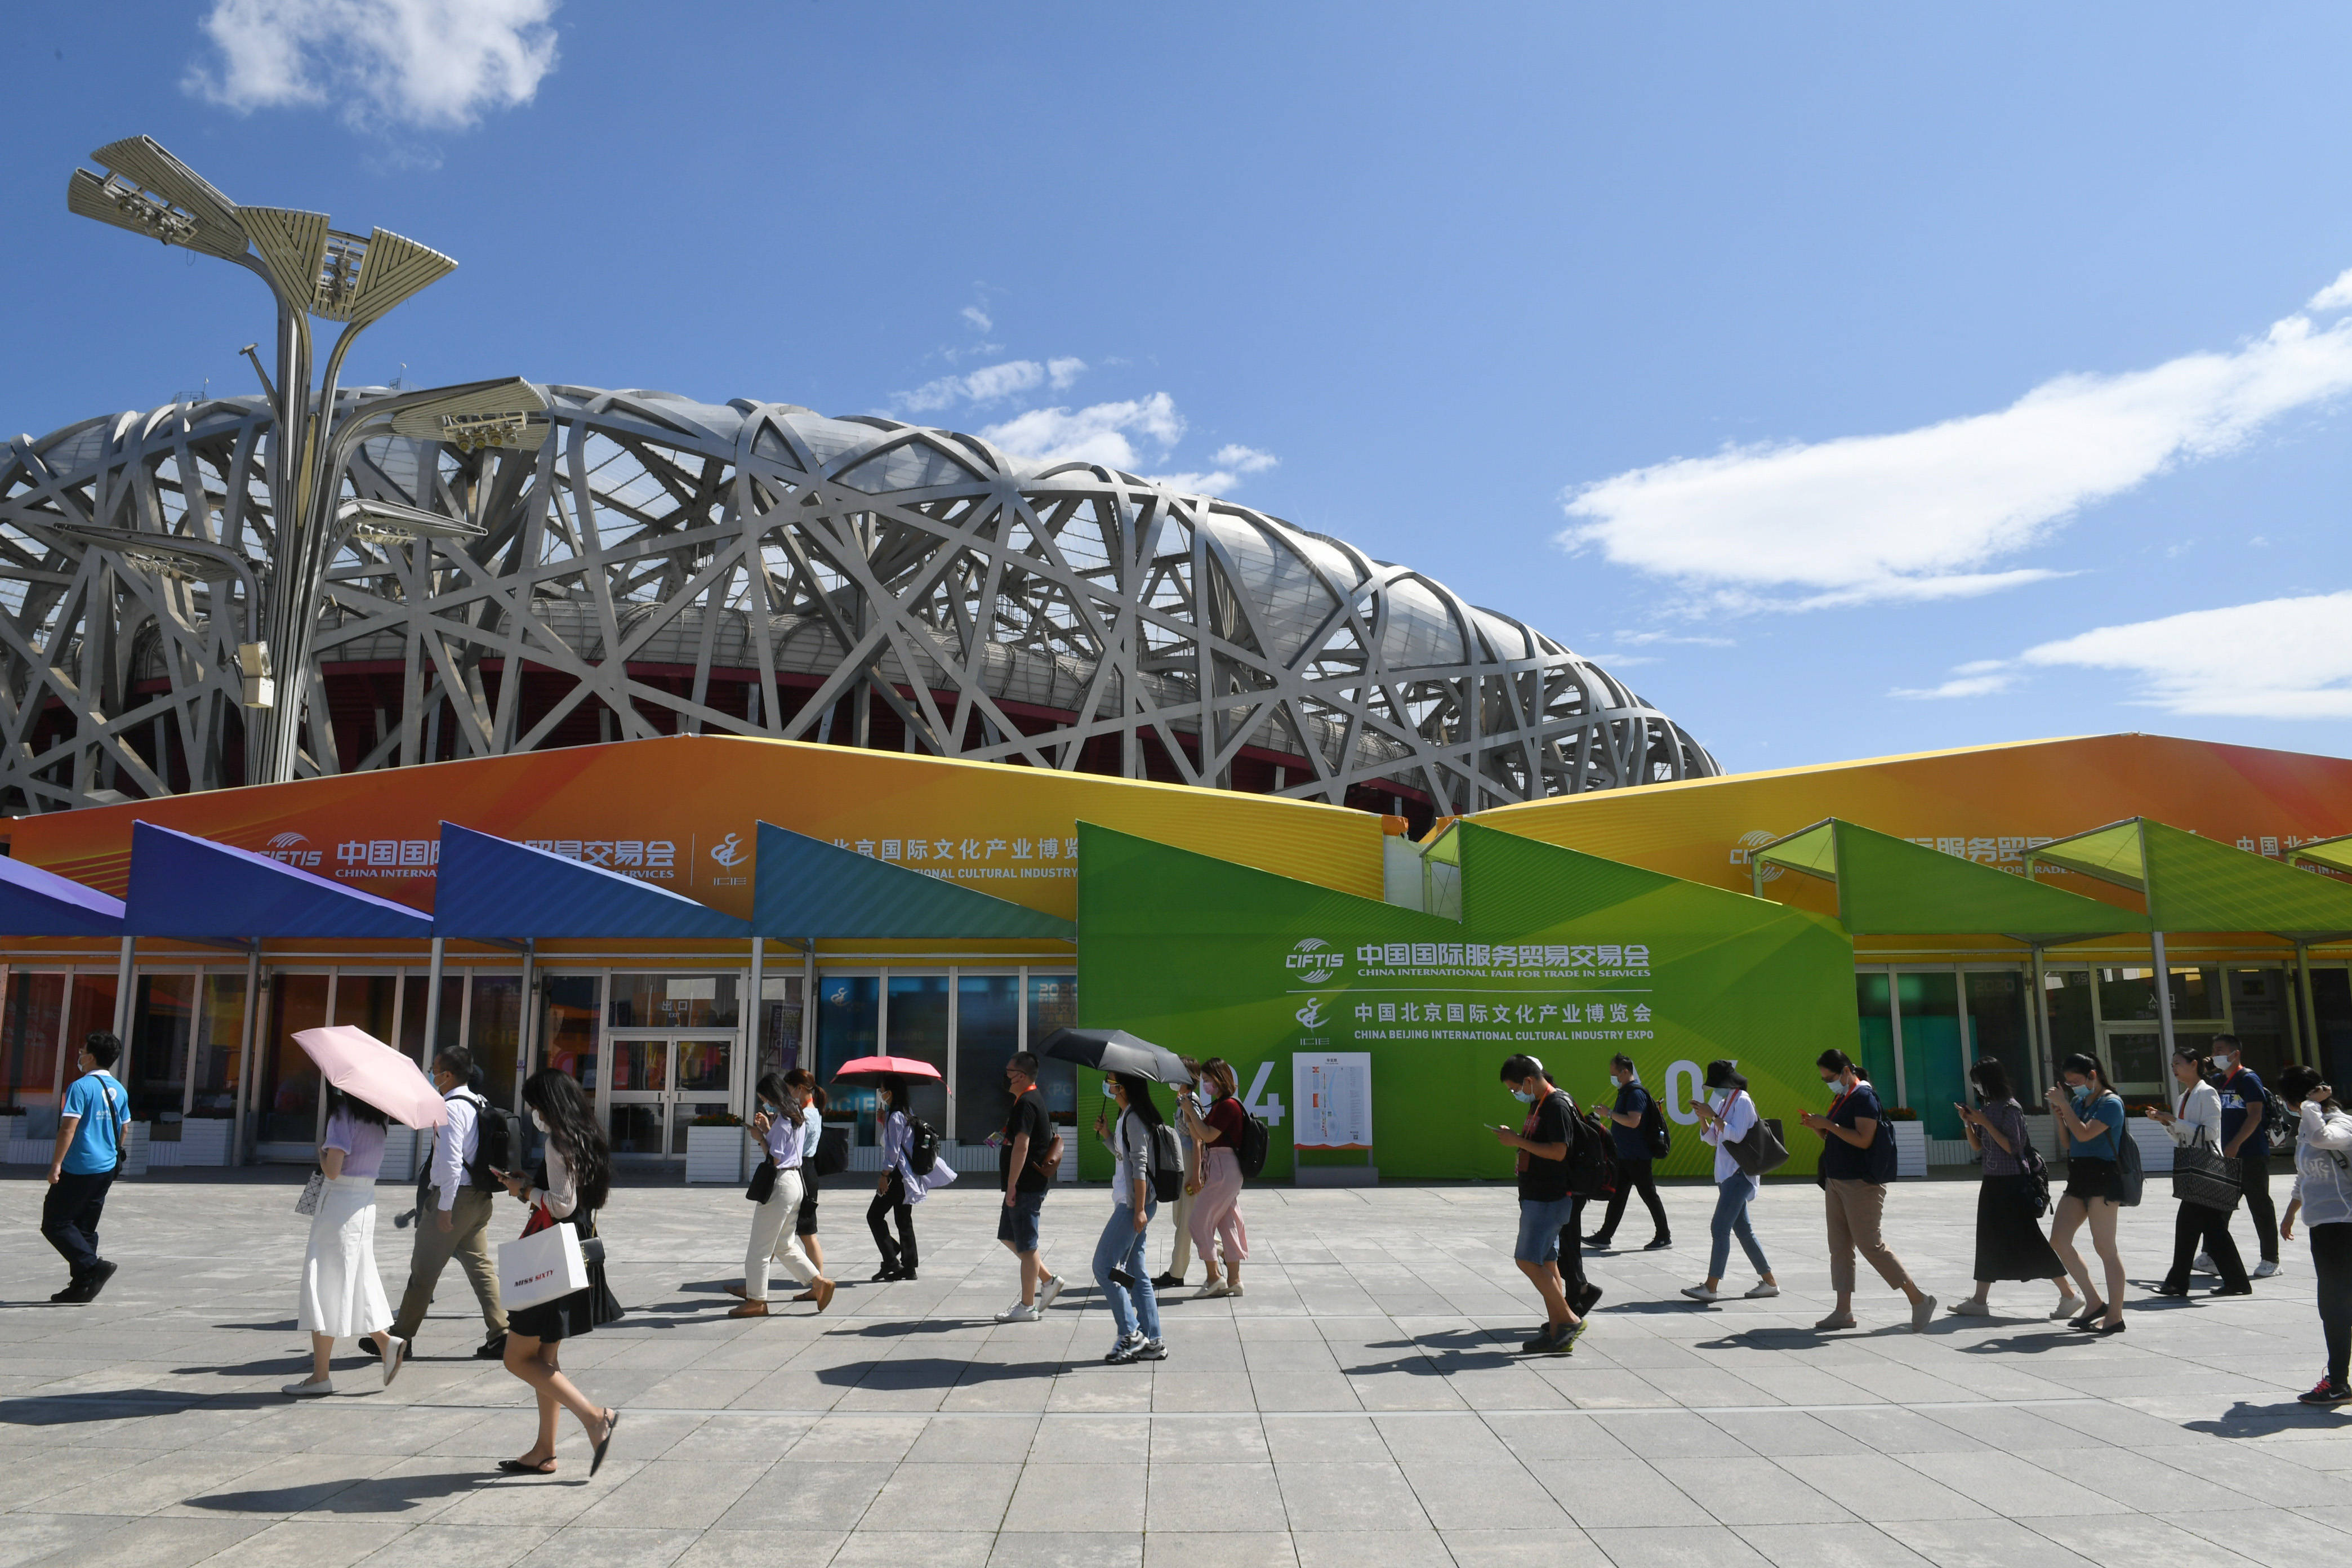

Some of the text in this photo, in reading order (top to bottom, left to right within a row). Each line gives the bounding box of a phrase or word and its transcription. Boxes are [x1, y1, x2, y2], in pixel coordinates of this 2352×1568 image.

[335, 869, 438, 877] CHINA INTERNA
[957, 868, 1017, 879] CULTURAL
[1020, 867, 1077, 878] INDUSTRY
[1285, 953, 1344, 968] CIFTIS
[1356, 943, 1650, 968] 中国国际服务贸易交易会
[1357, 968, 1395, 977] CHINA
[1398, 968, 1487, 977] INTERNATIONAL
[1491, 969, 1516, 978] FAIR
[1598, 969, 1651, 977] SERVICES
[662, 1000, 688, 1012] 出口
[1355, 1002, 1652, 1023] 中国北京国际文化产业博览会
[1354, 1030, 1654, 1041] CHINA BEIJING INTERNATIONAL CULTURAL INDUSTRY EXPO
[514, 1269, 555, 1287] MISS SIXTY
